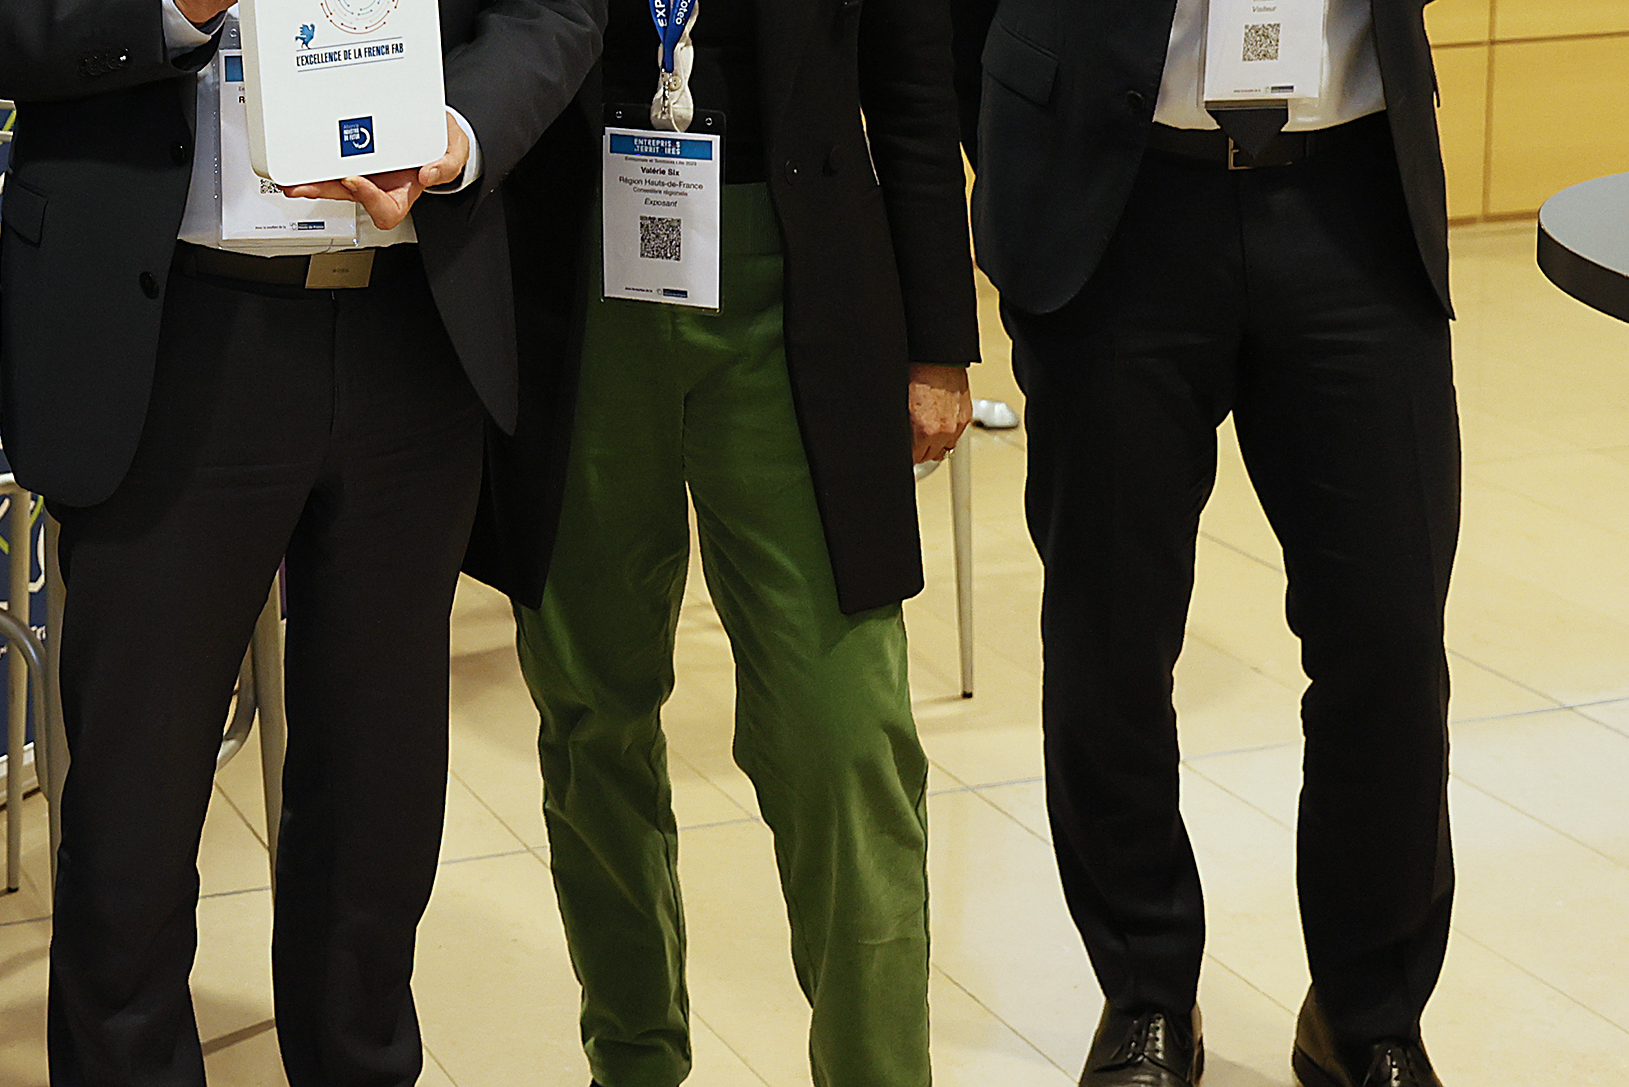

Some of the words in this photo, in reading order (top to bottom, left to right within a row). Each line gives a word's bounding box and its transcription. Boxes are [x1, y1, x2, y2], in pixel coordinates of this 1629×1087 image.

[296, 50, 342, 67] L'EXCELLENCE
[343, 49, 352, 61] DE
[354, 48, 363, 59] LA
[364, 44, 390, 58] FRENCH
[391, 42, 404, 55] FAB
[634, 138, 681, 148] ENTREPRISS
[636, 145, 681, 155] TERRITIRES
[640, 166, 666, 176] Valérie
[668, 168, 680, 177] Six
[619, 175, 643, 186] Région
[645, 177, 704, 190] Hauts-de-France
[644, 197, 678, 208] Exposant
